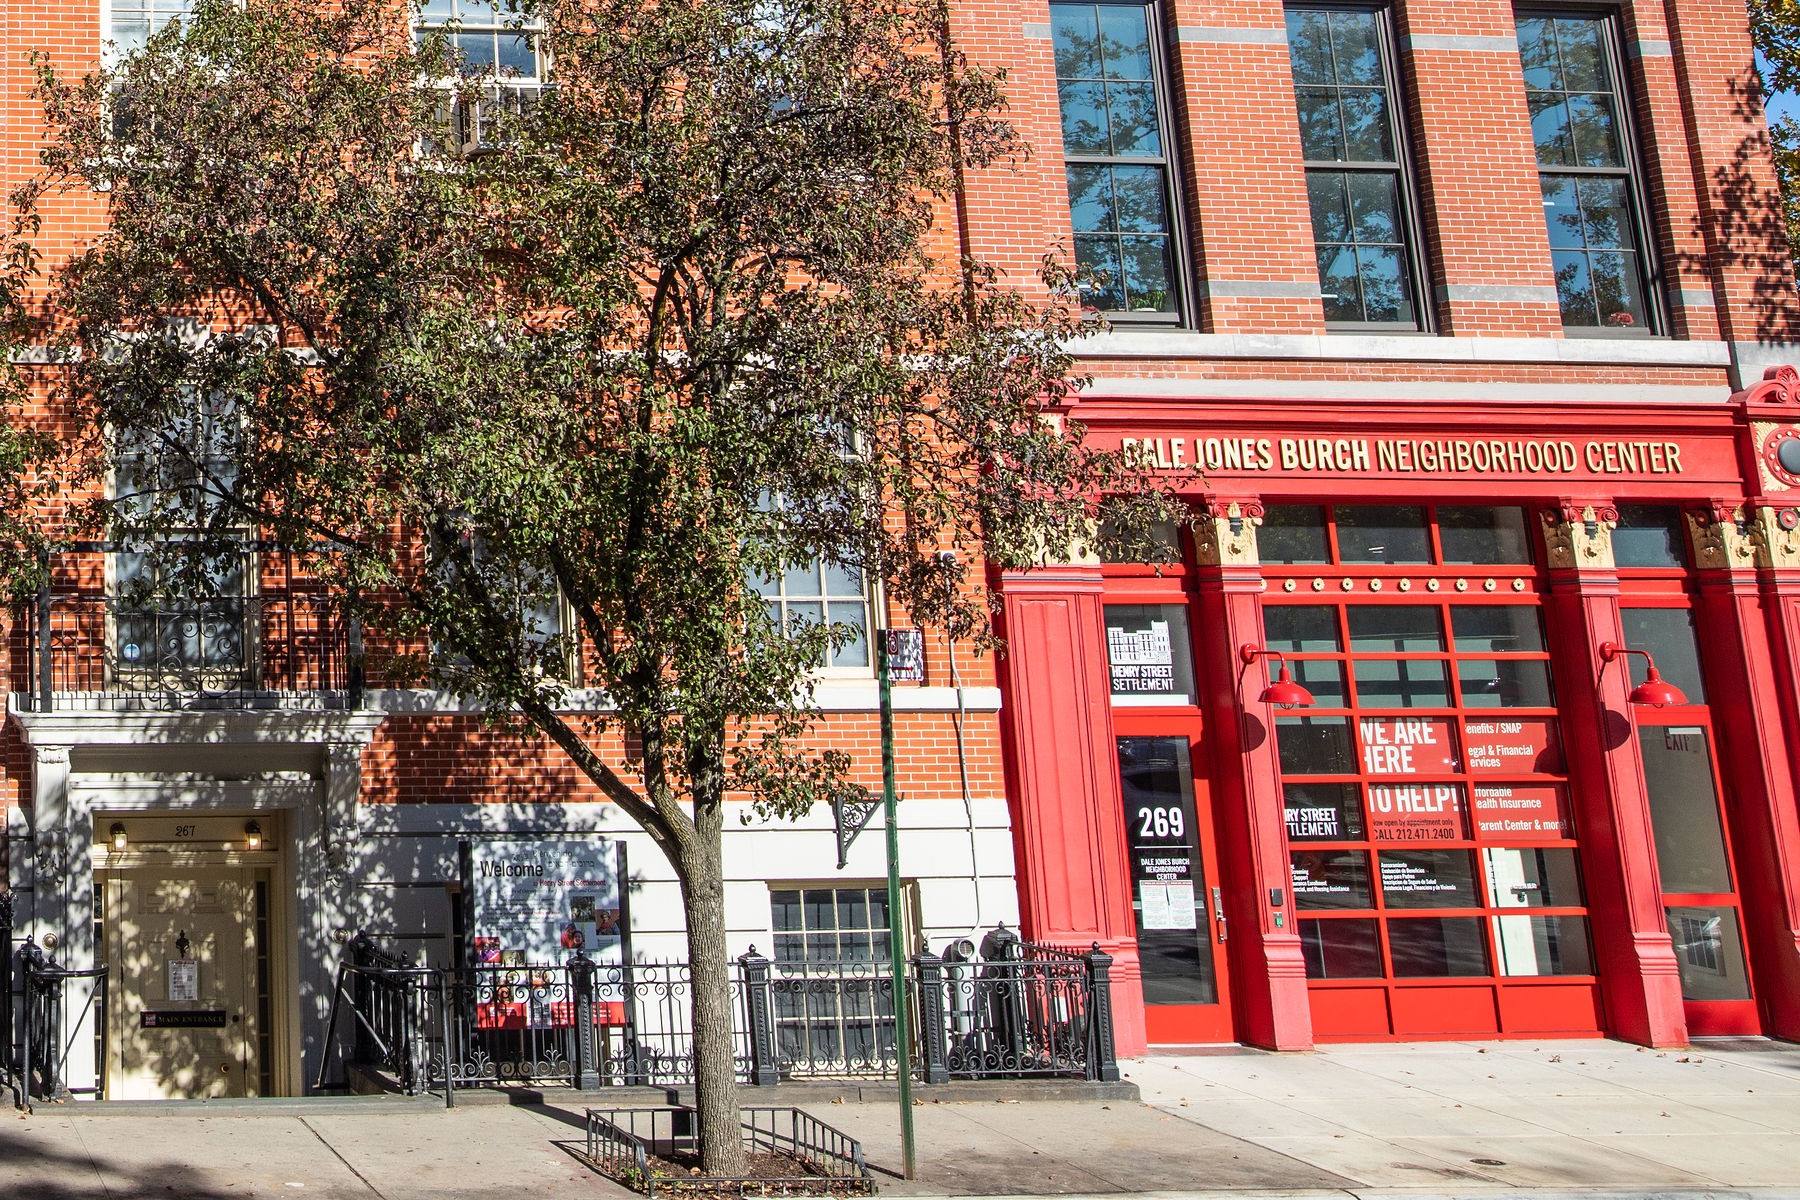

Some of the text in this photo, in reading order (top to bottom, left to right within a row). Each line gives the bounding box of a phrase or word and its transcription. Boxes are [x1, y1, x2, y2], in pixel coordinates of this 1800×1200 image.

[1195, 438, 1274, 470] JONES
[1280, 439, 1371, 471] BURCH
[1376, 440, 1578, 472] NEIGHBORHOOD
[1585, 442, 1683, 473] CENTER
[1111, 665, 1173, 677] HENRY STREET
[1113, 678, 1174, 690] SETTLEMENT
[1394, 717, 1437, 744] ARE
[1465, 723, 1494, 734] enefits
[1501, 723, 1522, 733] SNAP
[1468, 745, 1533, 758] egal & Financial
[1470, 757, 1501, 767] ervices
[1395, 784, 1459, 812] HELP!
[1474, 787, 1512, 797] ffordable
[1475, 798, 1541, 808] ealth Insurance
[1300, 807, 1336, 821] STREET
[1138, 807, 1185, 837] 269
[1478, 820, 1504, 831] arent
[1504, 820, 1532, 830] Center
[1534, 819, 1541, 830] &
[175, 825, 195, 837] 267
[1397, 828, 1455, 840] 212.471.2400
[1141, 858, 1154, 866] DALE
[480, 860, 543, 877] Welcome
